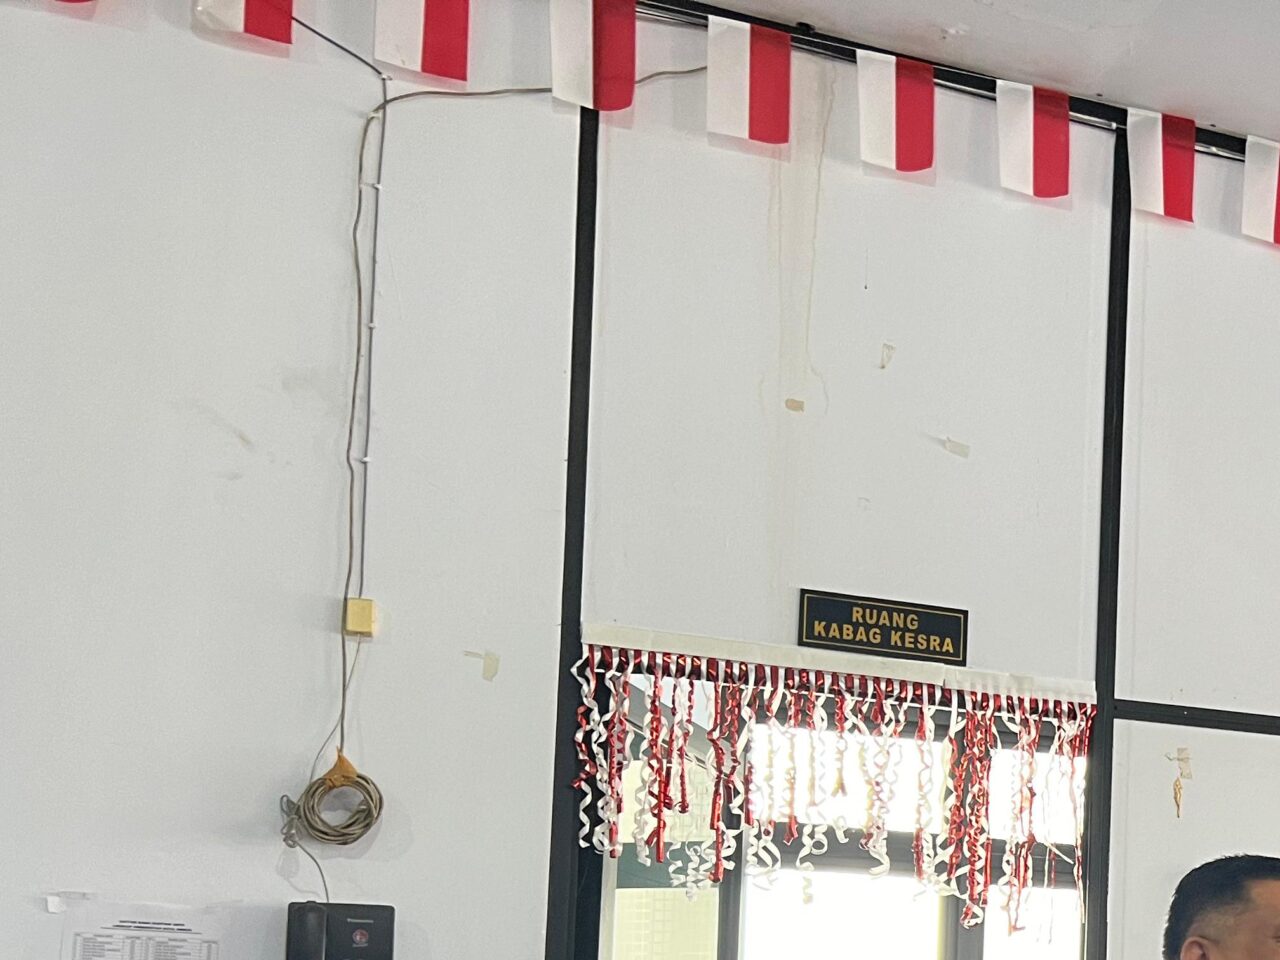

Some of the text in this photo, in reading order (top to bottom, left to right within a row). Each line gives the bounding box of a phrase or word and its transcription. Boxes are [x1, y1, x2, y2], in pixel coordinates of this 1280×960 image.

[852, 606, 919, 630] RUANG
[813, 620, 954, 653] KABAG KESRA
